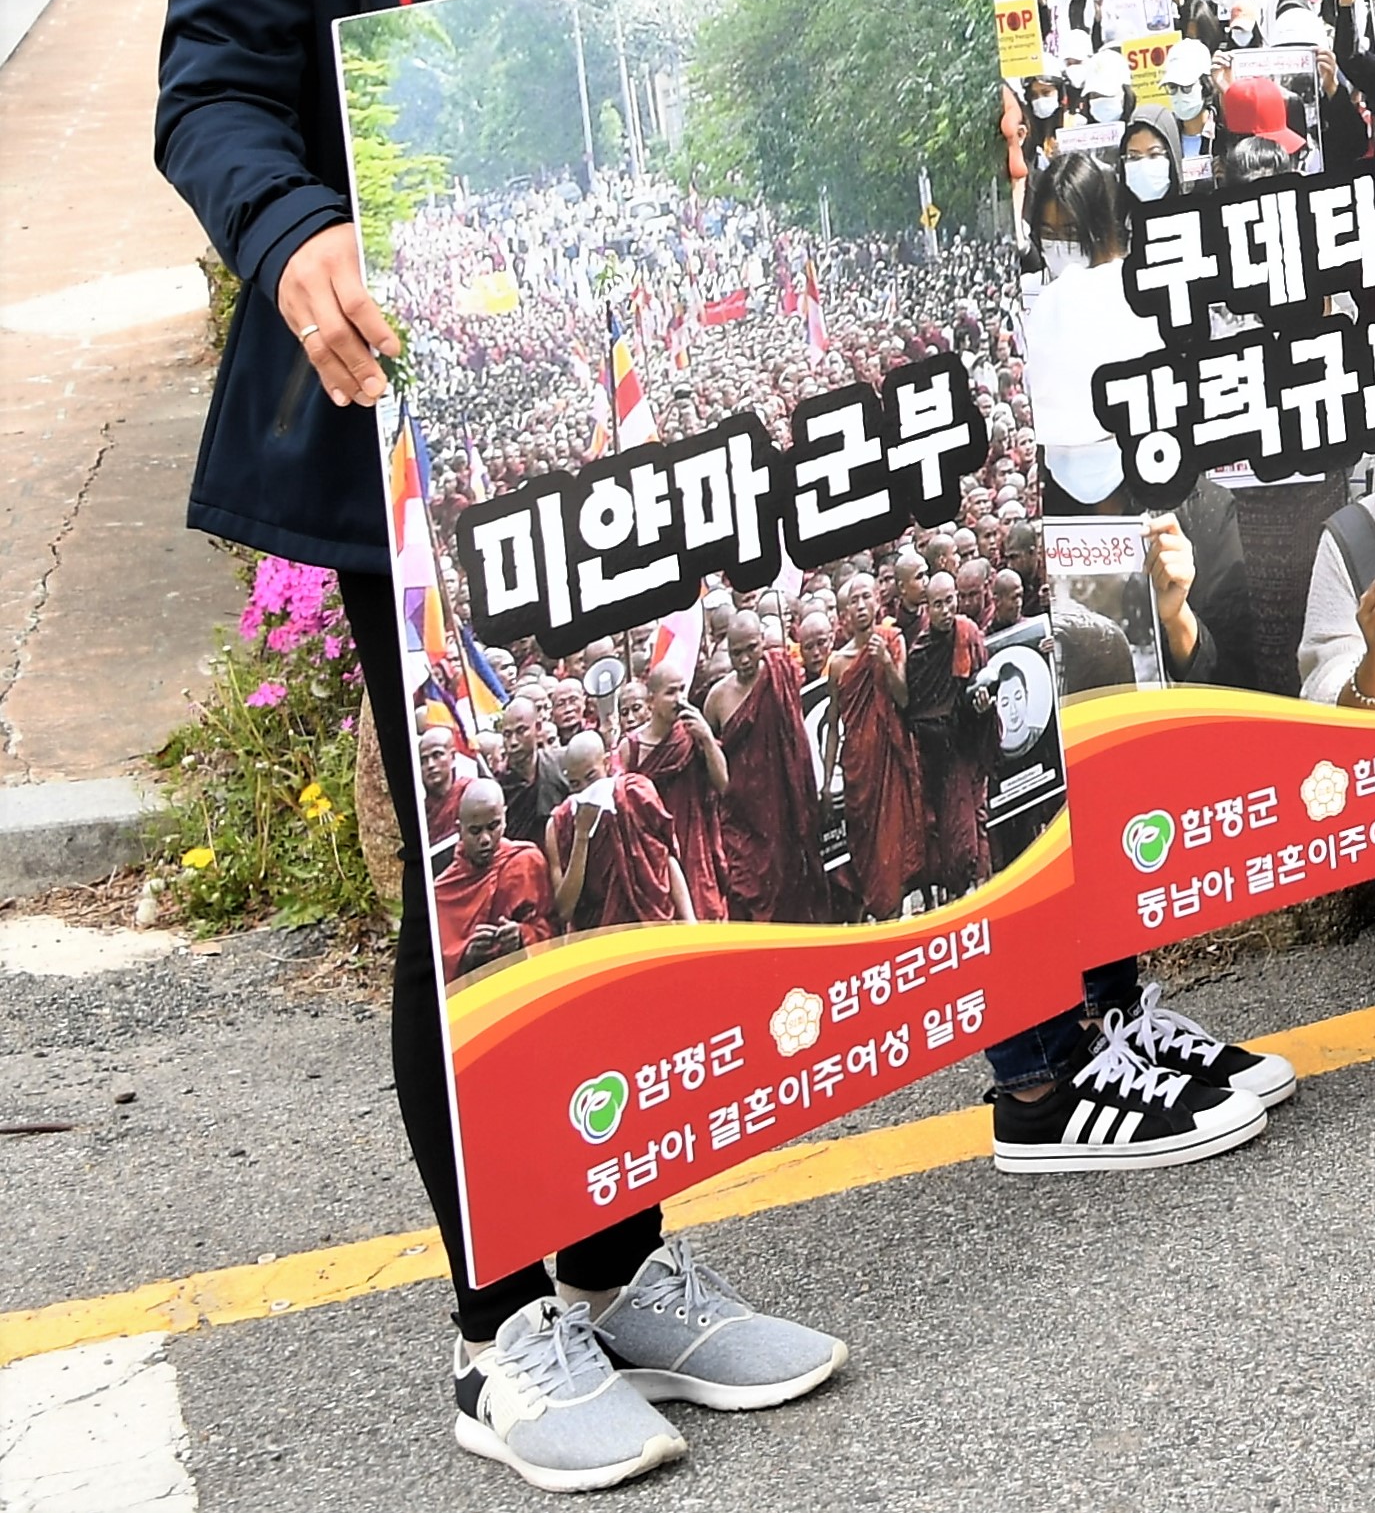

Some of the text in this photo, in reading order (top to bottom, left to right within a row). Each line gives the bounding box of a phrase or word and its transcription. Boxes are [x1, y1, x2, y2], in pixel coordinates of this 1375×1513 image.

[995, 10, 1033, 34] TOP
[472, 371, 975, 629] 미얀마 군부
[1181, 786, 1279, 849] 함평군
[1136, 866, 1235, 929] 동남아
[634, 917, 992, 1110] 함평군 함평군의회
[586, 989, 987, 1206] 동남아 결혼이주여성 일동
